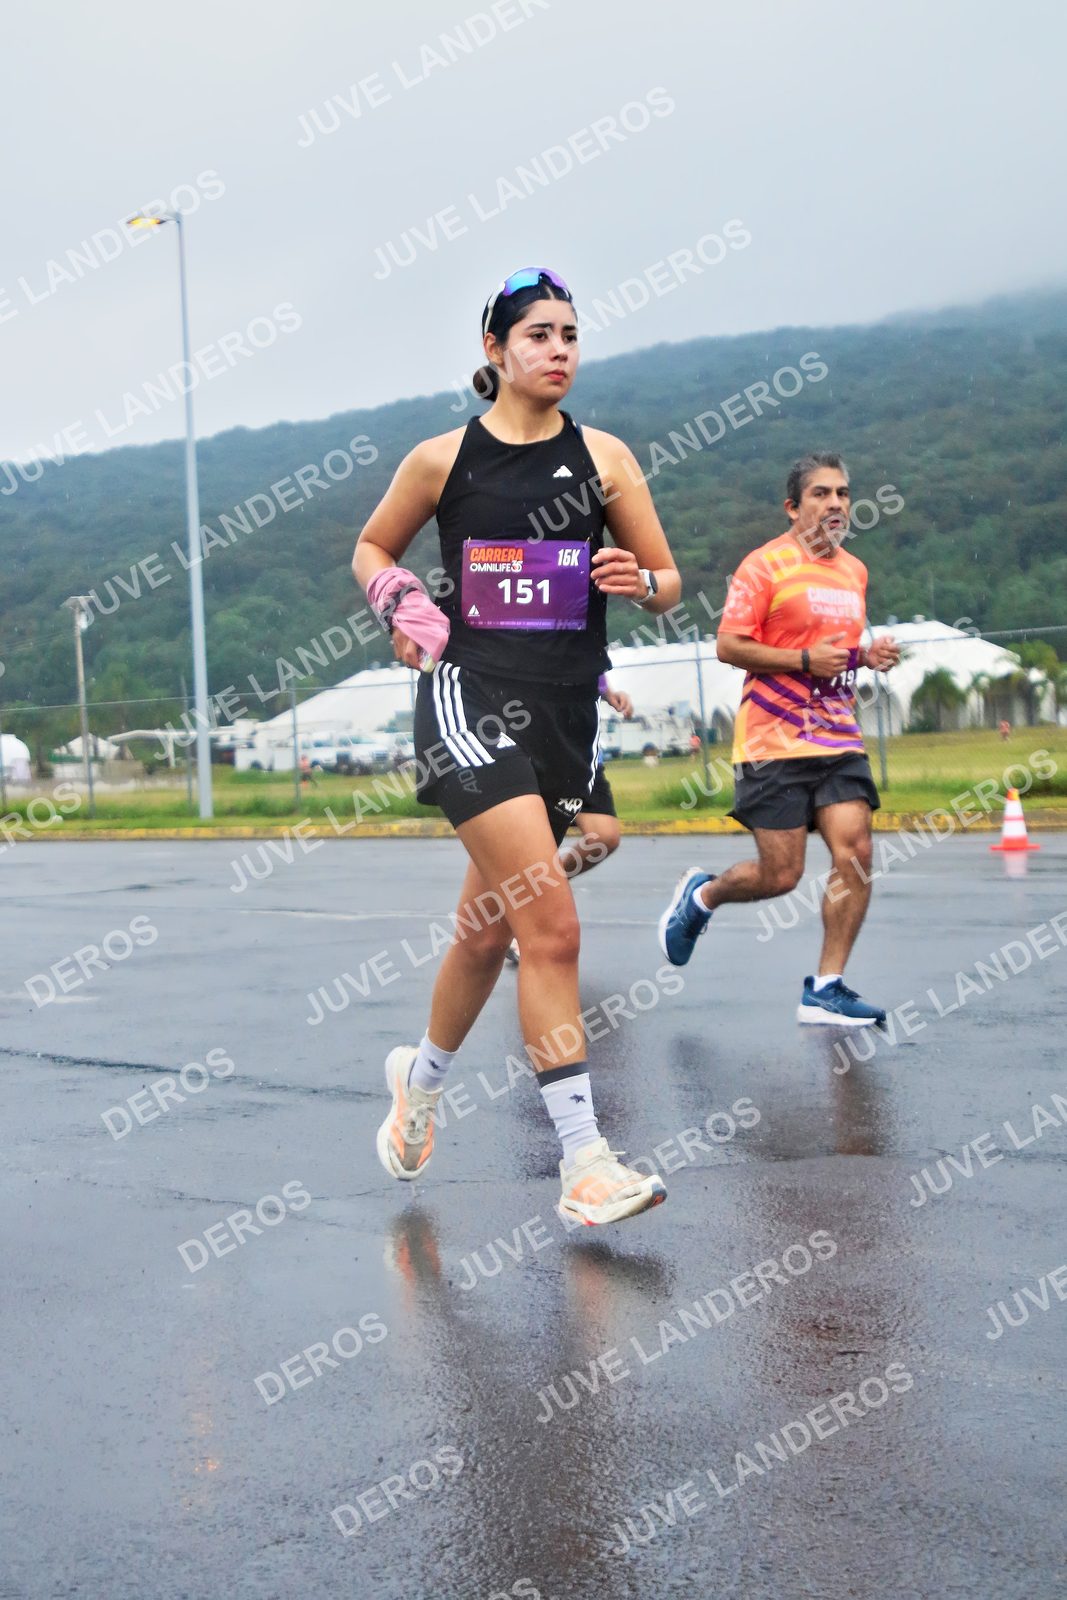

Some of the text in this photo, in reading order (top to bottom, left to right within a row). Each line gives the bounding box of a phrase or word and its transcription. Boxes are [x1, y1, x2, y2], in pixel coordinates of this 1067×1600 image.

[470, 548, 523, 562] CARRERA
[558, 549, 580, 566] 16K
[498, 579, 550, 604] 151
